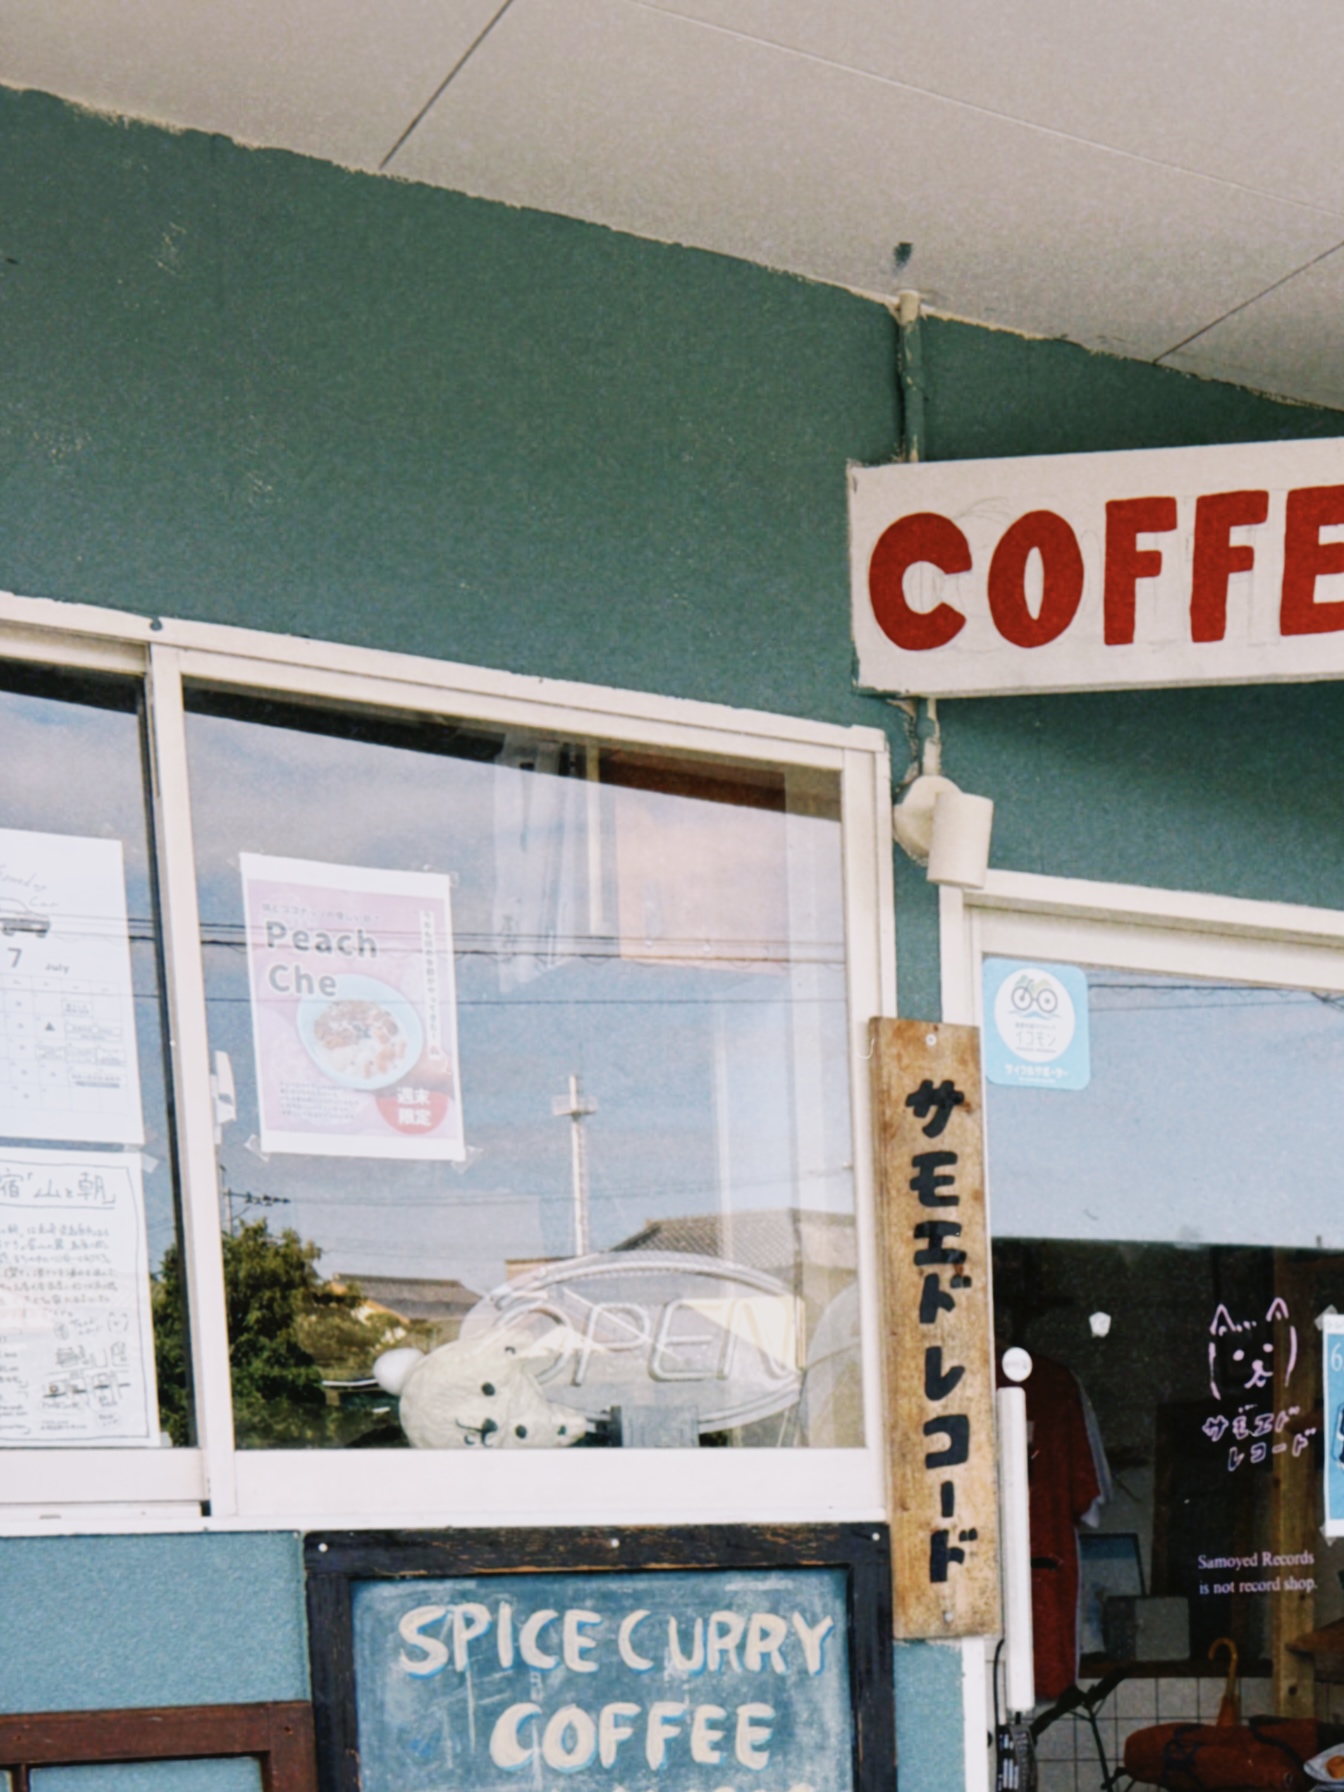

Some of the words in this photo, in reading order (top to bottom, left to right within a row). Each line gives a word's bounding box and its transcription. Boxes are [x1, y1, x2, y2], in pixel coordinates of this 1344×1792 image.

[8, 947, 22, 969] 7
[265, 919, 379, 958] Peach
[268, 964, 337, 997] Che
[904, 1079, 979, 1584] サモエドレコード
[1228, 1427, 1317, 1471] レコード
[1198, 1552, 1258, 1571] Samoyed
[1262, 1550, 1315, 1566] Records
[1199, 1581, 1210, 1595] is
[1213, 1581, 1235, 1594] not
[1239, 1576, 1280, 1592] record
[1283, 1576, 1318, 1593] shop.
[399, 1602, 602, 1678] SPICE
[618, 1608, 834, 1677] CURRY
[490, 1700, 776, 1773] COFFEE
